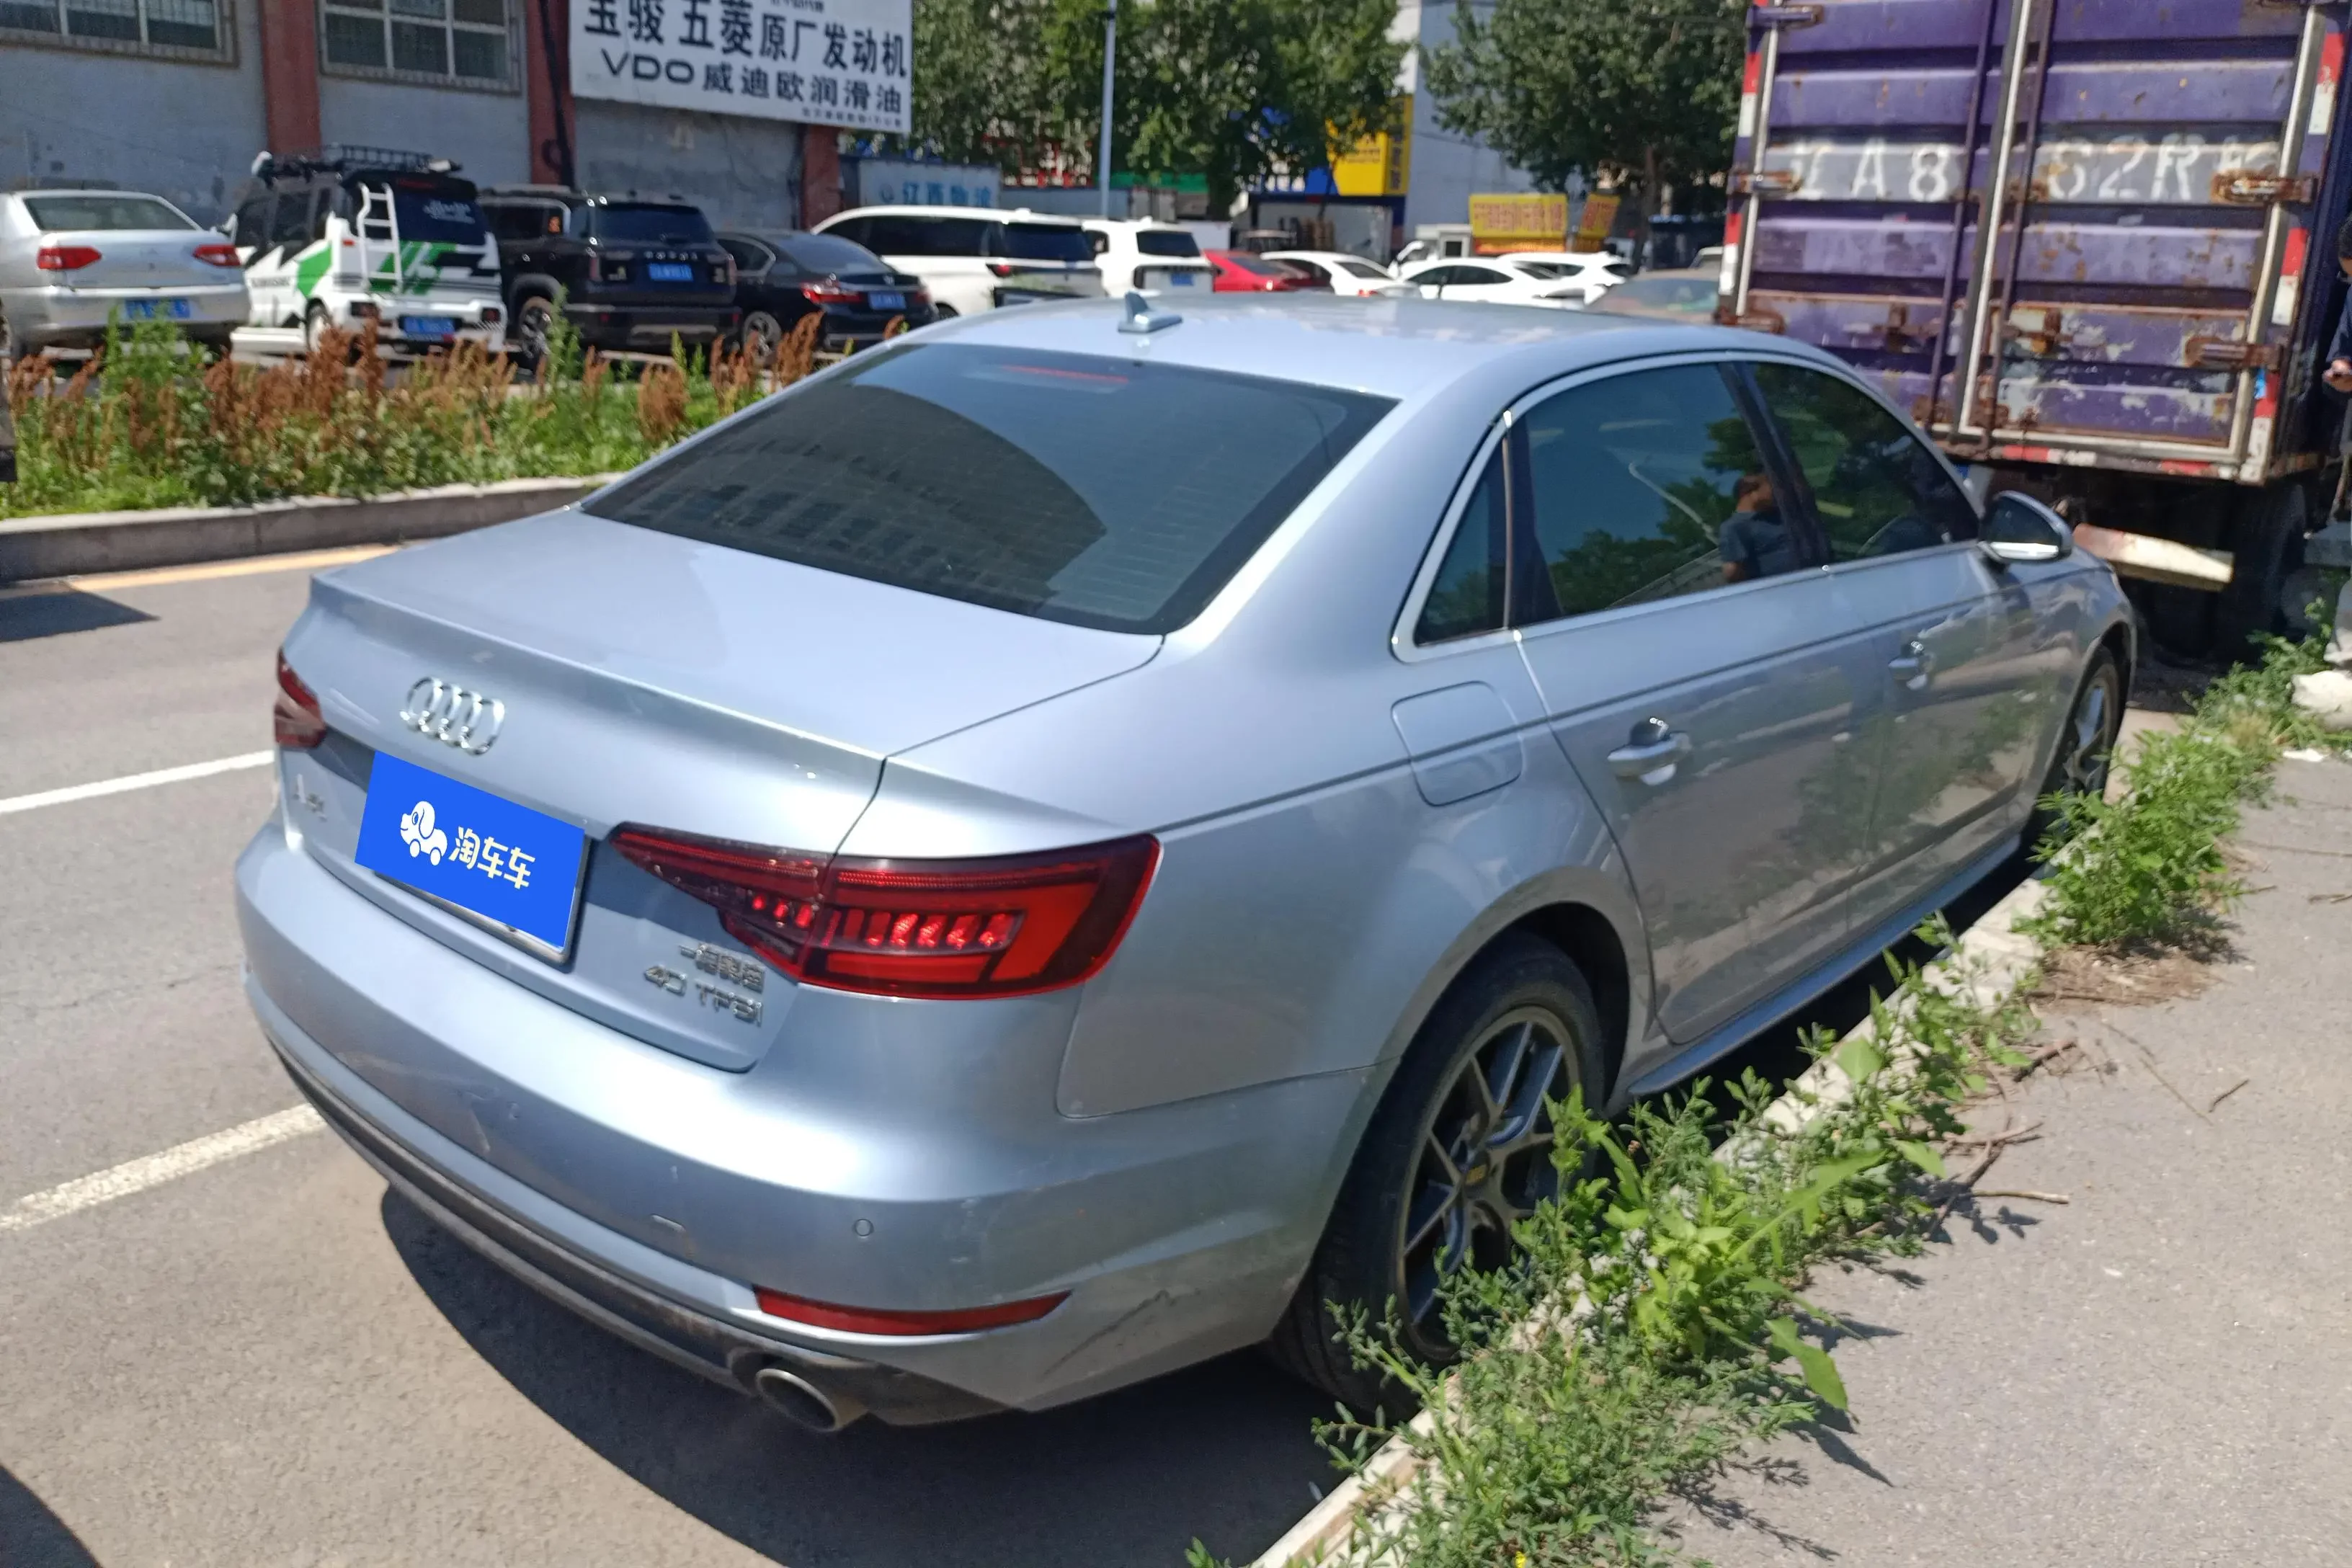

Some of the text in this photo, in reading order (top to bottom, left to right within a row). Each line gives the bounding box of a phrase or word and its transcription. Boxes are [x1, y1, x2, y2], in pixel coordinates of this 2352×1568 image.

[600, 48, 902, 114] VDO 威迪欧润滑油
[643, 964, 763, 1028] 40 TFSI
